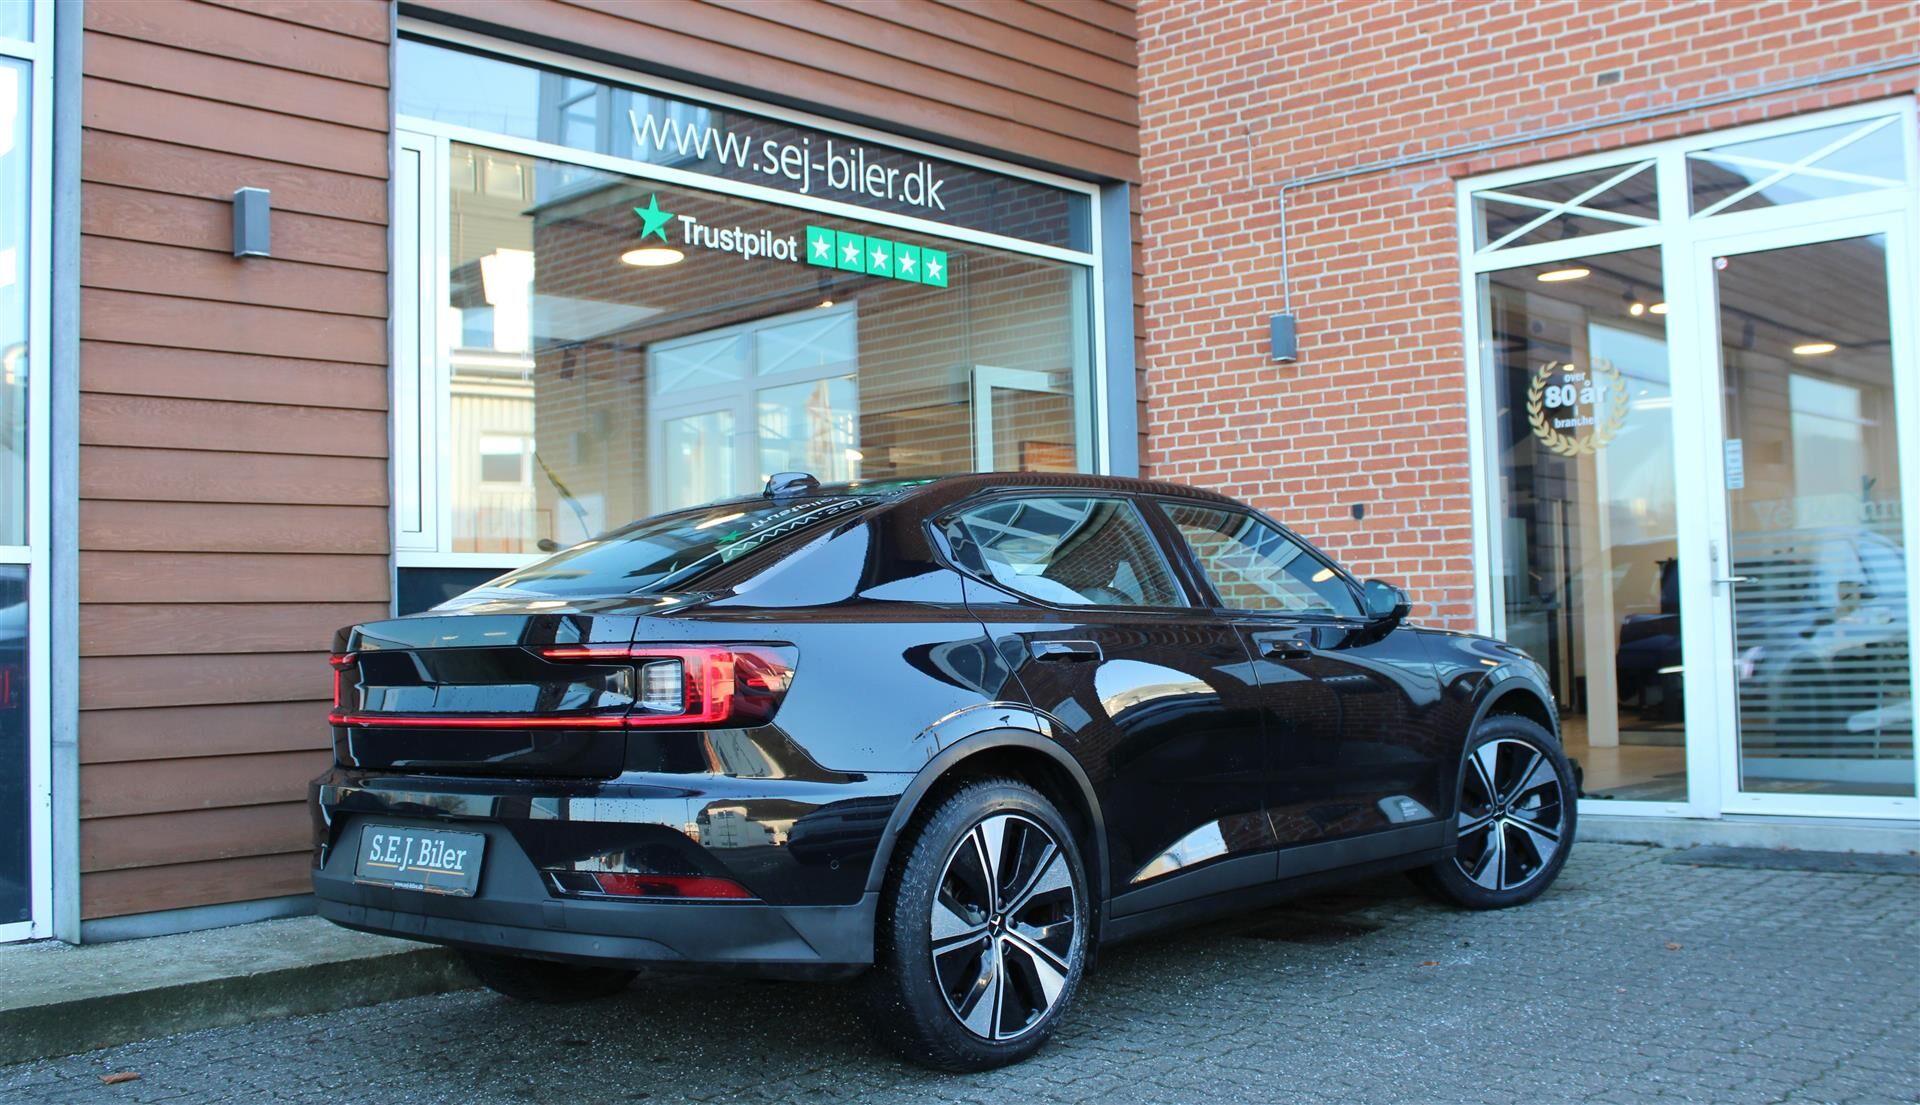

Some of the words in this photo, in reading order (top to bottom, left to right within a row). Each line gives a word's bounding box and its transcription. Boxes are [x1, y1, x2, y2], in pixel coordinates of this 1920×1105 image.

[629, 109, 945, 210] www.sej-biler.dk
[678, 215, 798, 262] Trustpilot
[1545, 384, 1576, 408] 80
[369, 834, 413, 871] S.E.J.
[416, 838, 467, 870] Biler
